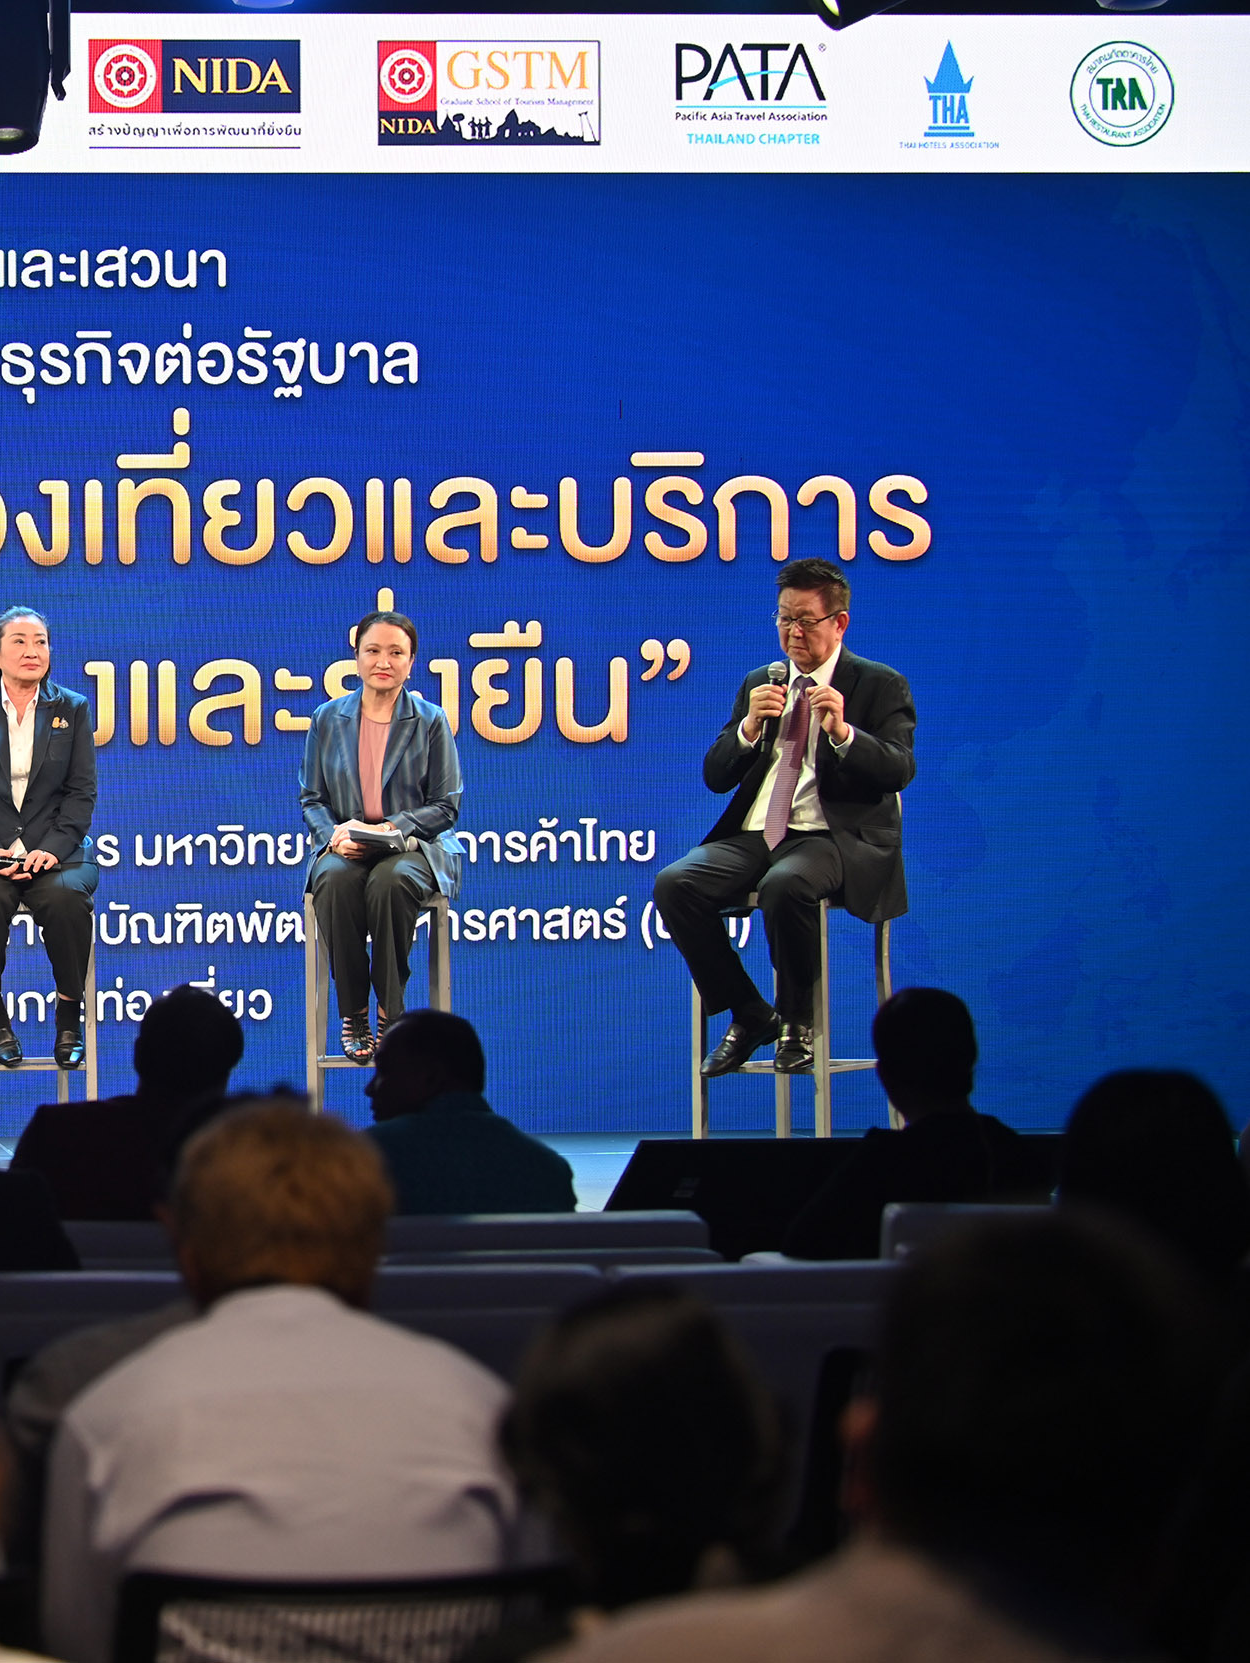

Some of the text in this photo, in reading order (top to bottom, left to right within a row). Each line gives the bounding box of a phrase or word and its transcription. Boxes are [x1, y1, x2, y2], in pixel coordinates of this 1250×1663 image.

[172, 57, 293, 94] NIDA
[447, 50, 589, 90] GSTM
[675, 43, 826, 101] PATA
[440, 97, 473, 106] Graduate
[476, 97, 501, 106] School
[515, 97, 545, 106] Tourism
[547, 97, 594, 107] Management
[1095, 77, 1148, 111] TRA
[675, 111, 828, 121] Pacific Asia Travel Association
[929, 95, 969, 124] THA
[380, 118, 436, 134] NIDA
[687, 133, 821, 145] THAILAND CHAPTER
[918, 141, 947, 149] HOTELS
[950, 141, 1000, 149] ASSOCIATION
